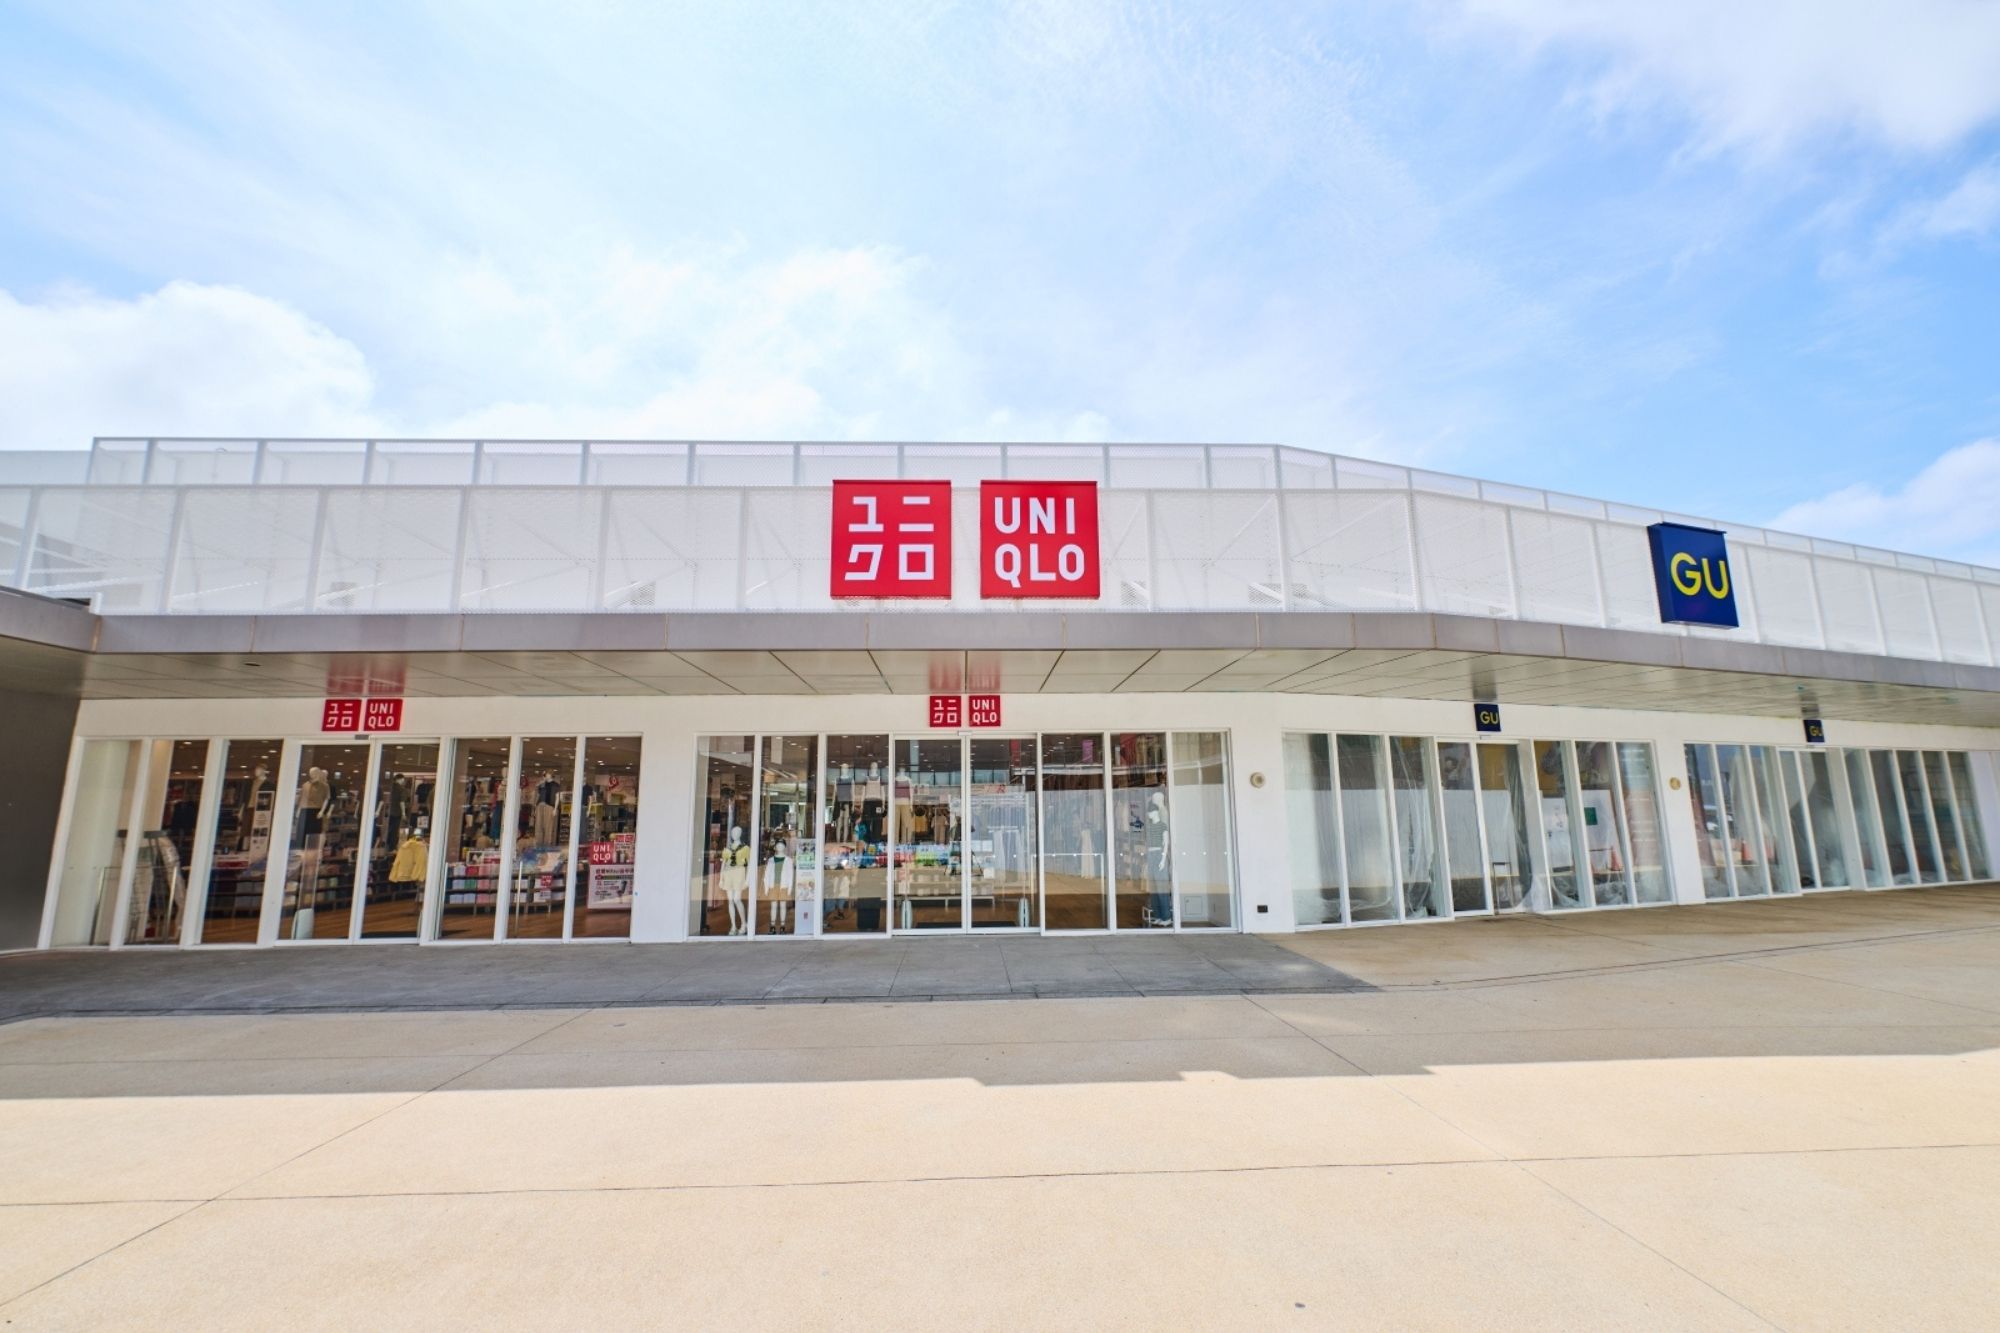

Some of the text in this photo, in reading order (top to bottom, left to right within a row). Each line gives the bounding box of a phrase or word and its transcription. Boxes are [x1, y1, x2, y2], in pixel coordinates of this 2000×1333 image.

[848, 496, 934, 532] ユニ
[994, 497, 1075, 535] UNI
[844, 544, 934, 581] クロ
[994, 543, 1085, 588] QLO
[1670, 552, 1729, 599] GU
[328, 703, 353, 714] ユニ
[369, 703, 394, 714] UNI
[934, 699, 957, 710] ユニ
[972, 699, 995, 710] UNI
[325, 716, 352, 728] クロ
[368, 716, 395, 729] QLO
[933, 712, 957, 723] クロ
[973, 712, 997, 725] QLO
[1480, 711, 1498, 725] GU
[593, 844, 610, 853] UNI
[593, 853, 611, 862] QLO
